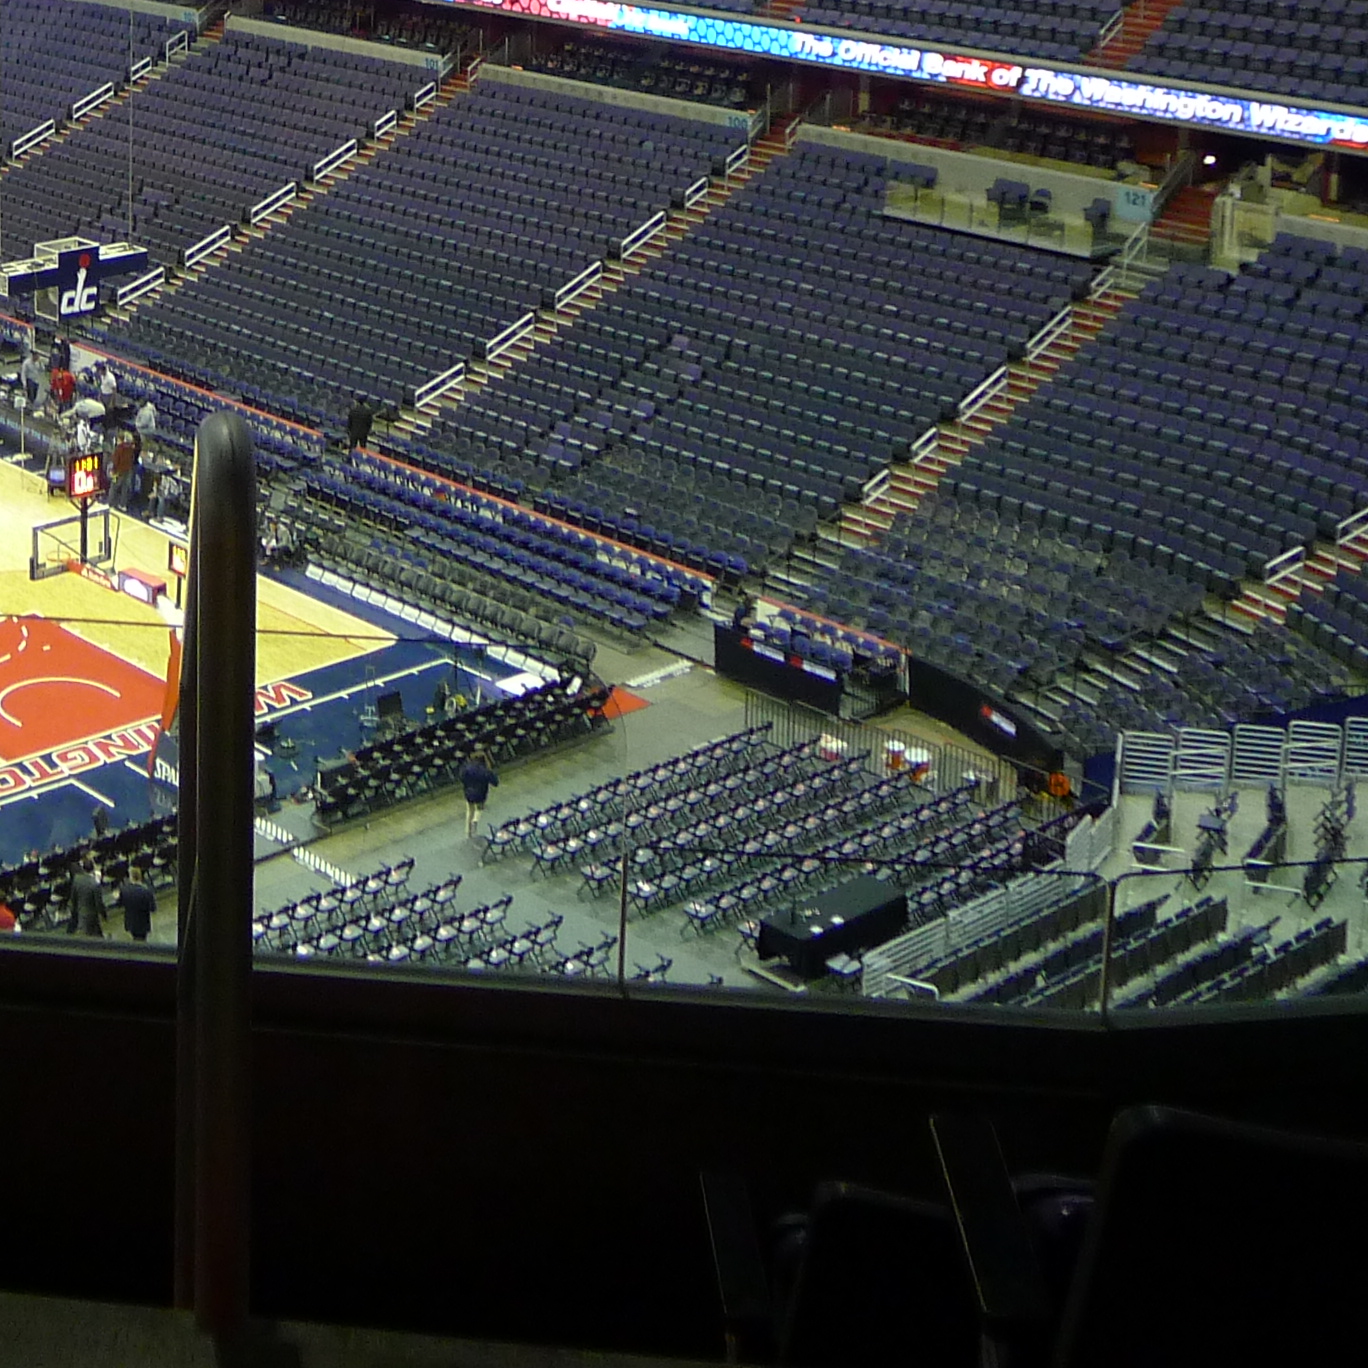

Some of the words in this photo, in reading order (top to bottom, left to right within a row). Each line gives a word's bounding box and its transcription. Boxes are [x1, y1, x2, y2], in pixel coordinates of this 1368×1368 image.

[793, 31, 834, 58] The
[838, 39, 922, 72] Official
[922, 51, 989, 85] Bank
[991, 64, 1023, 89] of
[1023, 68, 1075, 98] The
[1081, 76, 1243, 125] Washington
[1125, 190, 1146, 207] 121
